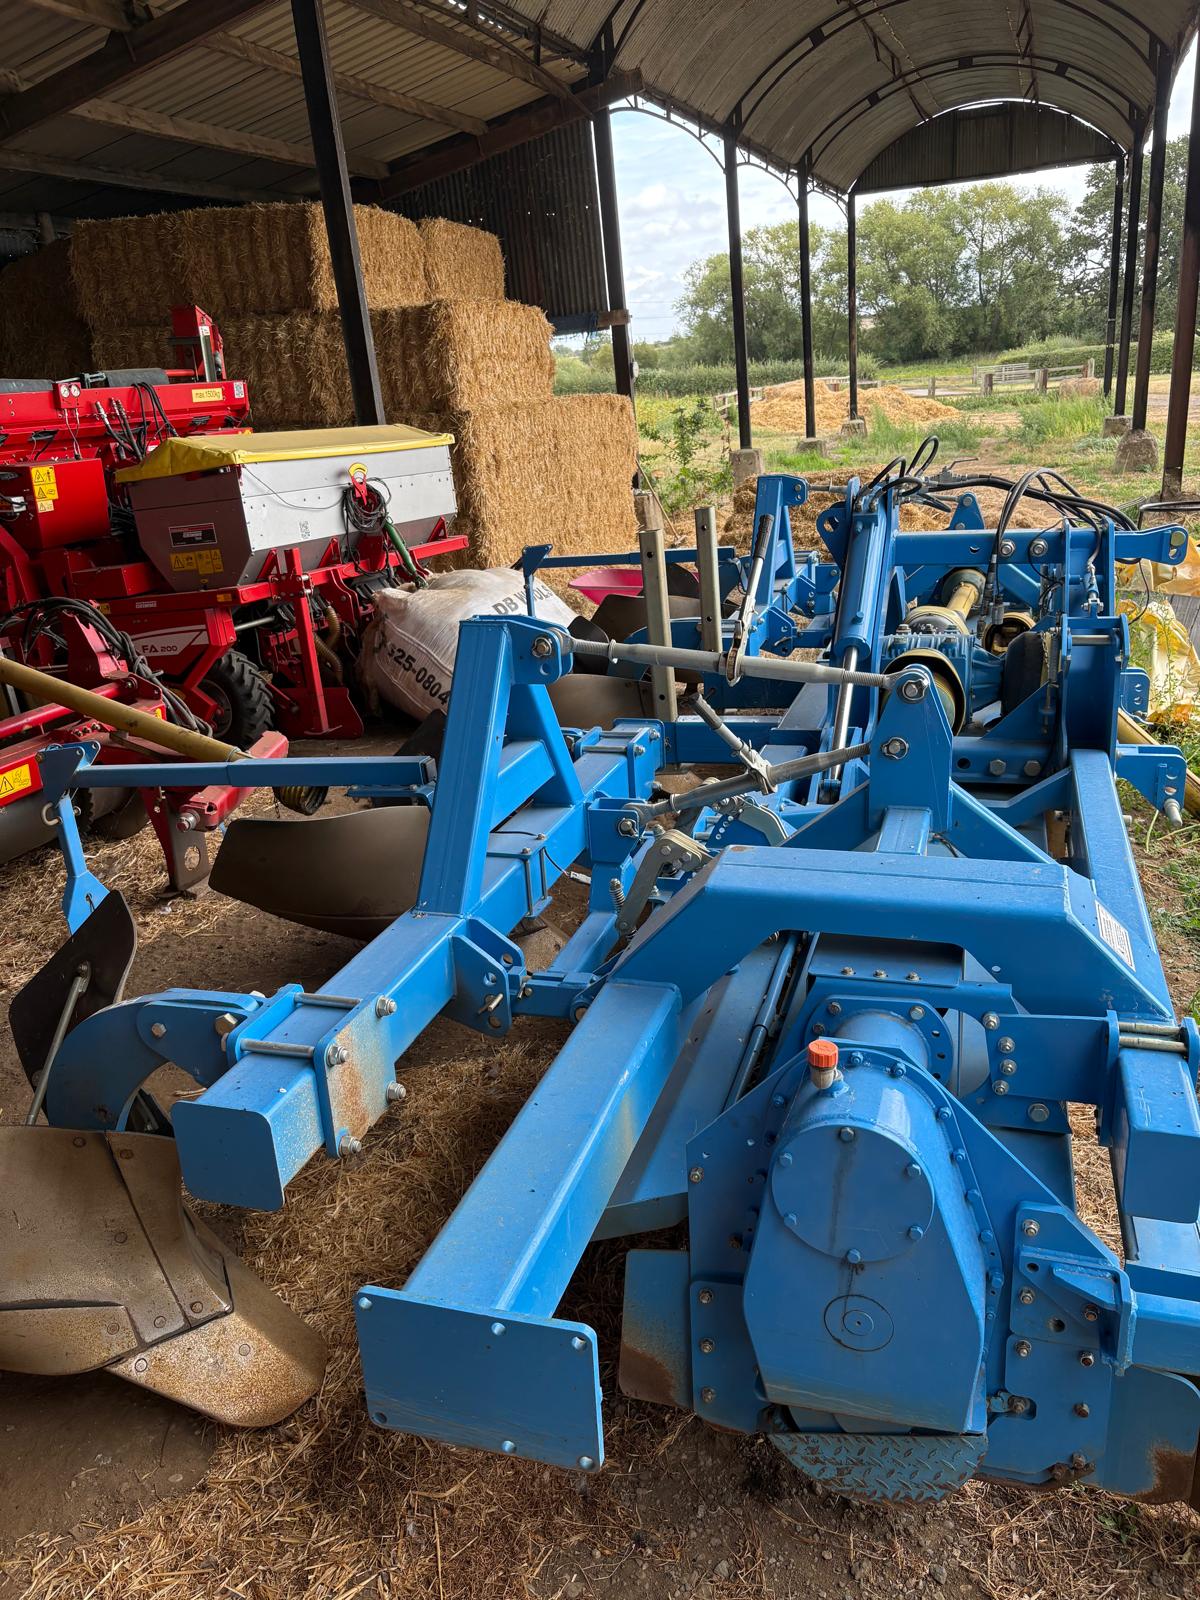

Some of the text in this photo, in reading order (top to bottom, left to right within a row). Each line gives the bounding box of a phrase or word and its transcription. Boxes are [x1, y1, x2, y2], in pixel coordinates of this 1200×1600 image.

[491, 597, 519, 615] DB
[141, 645, 178, 653] FA 200
